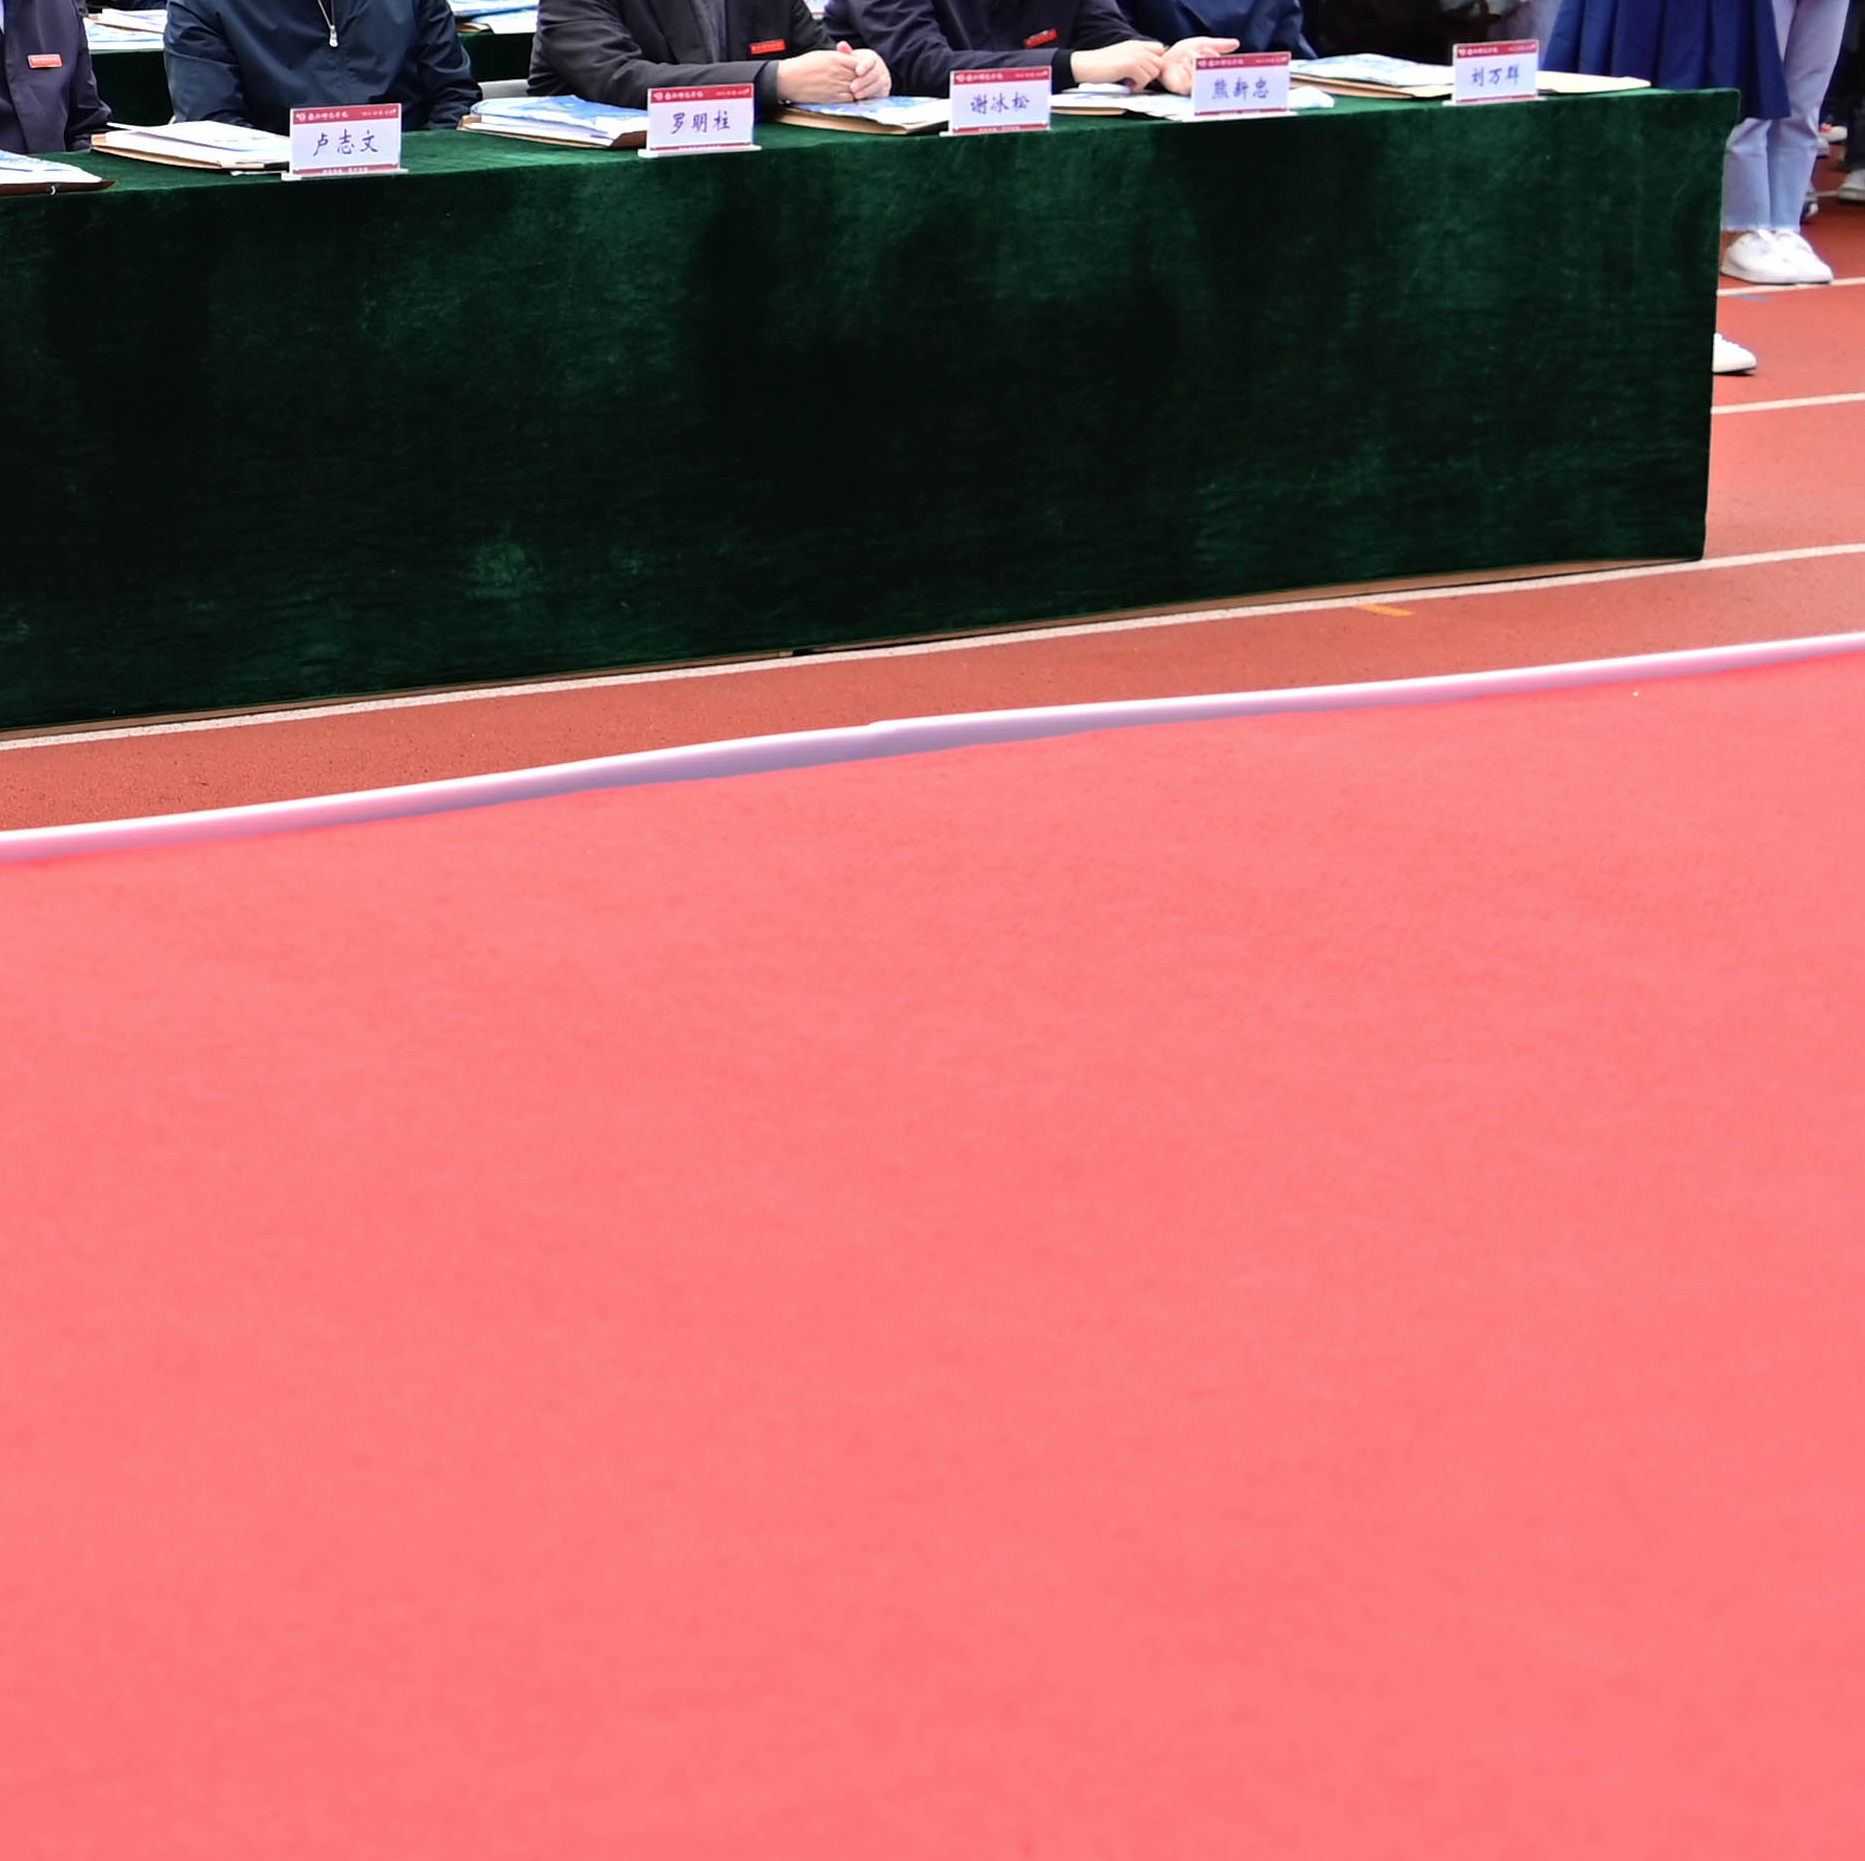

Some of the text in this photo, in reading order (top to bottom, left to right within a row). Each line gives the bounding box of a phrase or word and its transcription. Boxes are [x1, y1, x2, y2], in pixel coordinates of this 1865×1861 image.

[670, 110, 731, 135] 罗明柱
[312, 128, 378, 157] 卢志文
